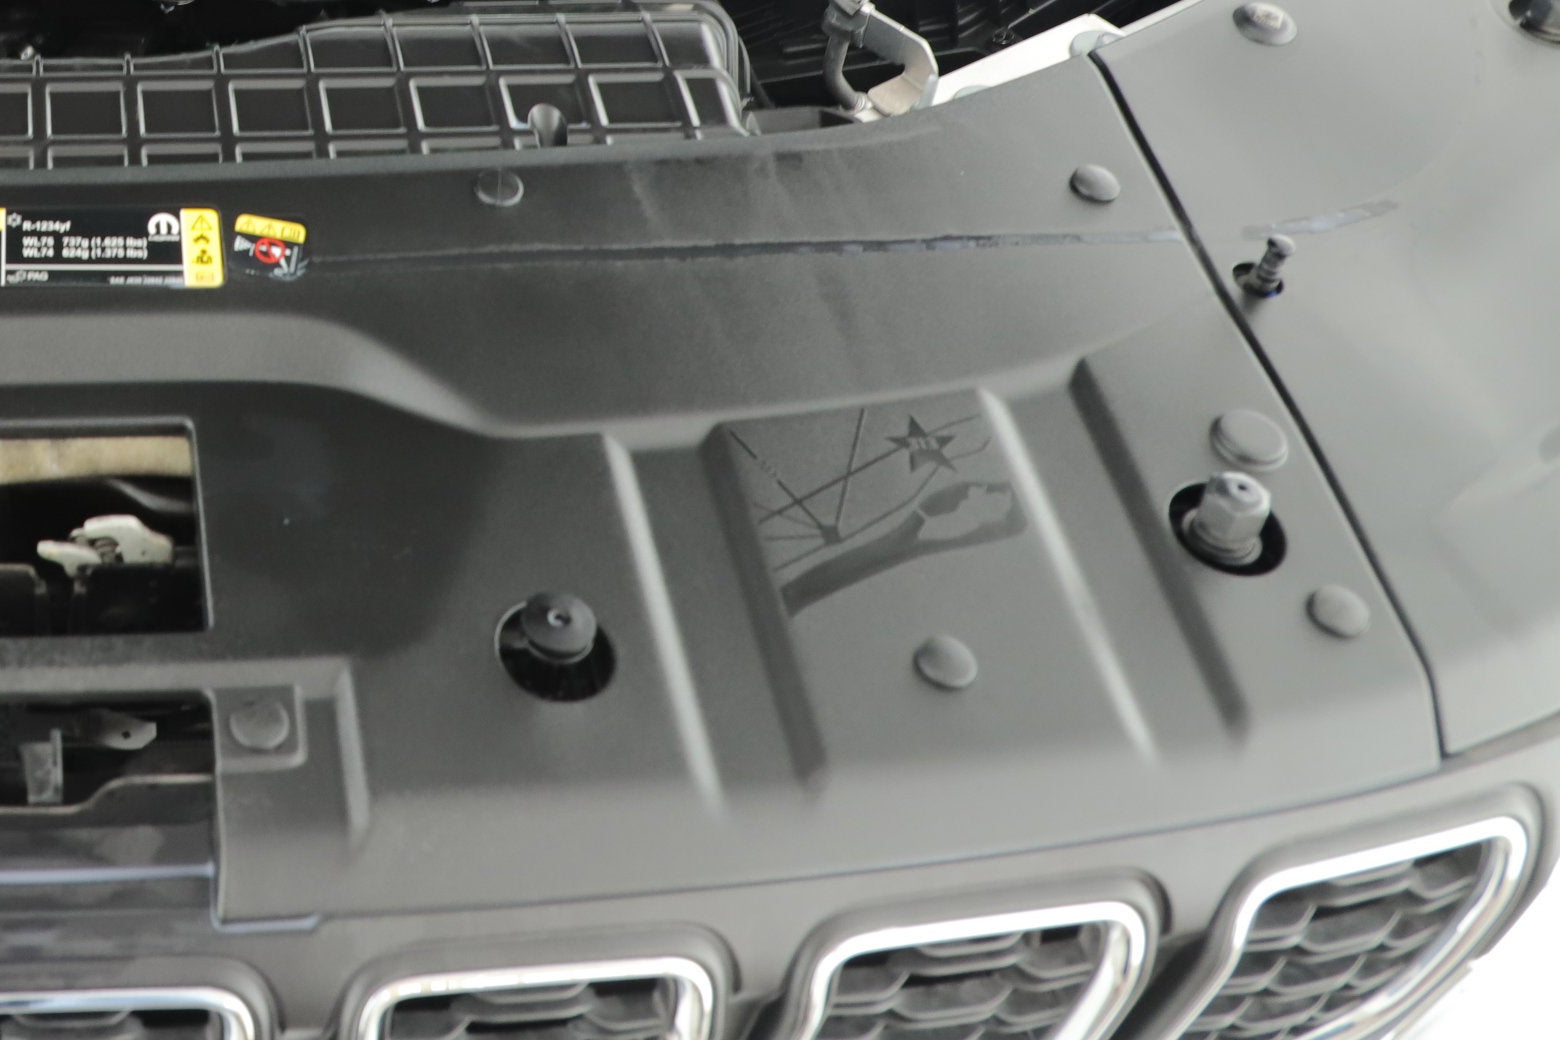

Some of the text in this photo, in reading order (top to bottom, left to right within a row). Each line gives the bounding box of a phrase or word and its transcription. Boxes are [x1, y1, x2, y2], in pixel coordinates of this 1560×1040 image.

[22, 220, 72, 234] R-1234yf
[62, 236, 90, 249] 737g
[126, 236, 148, 249] lbs)
[126, 247, 148, 260] lbs)
